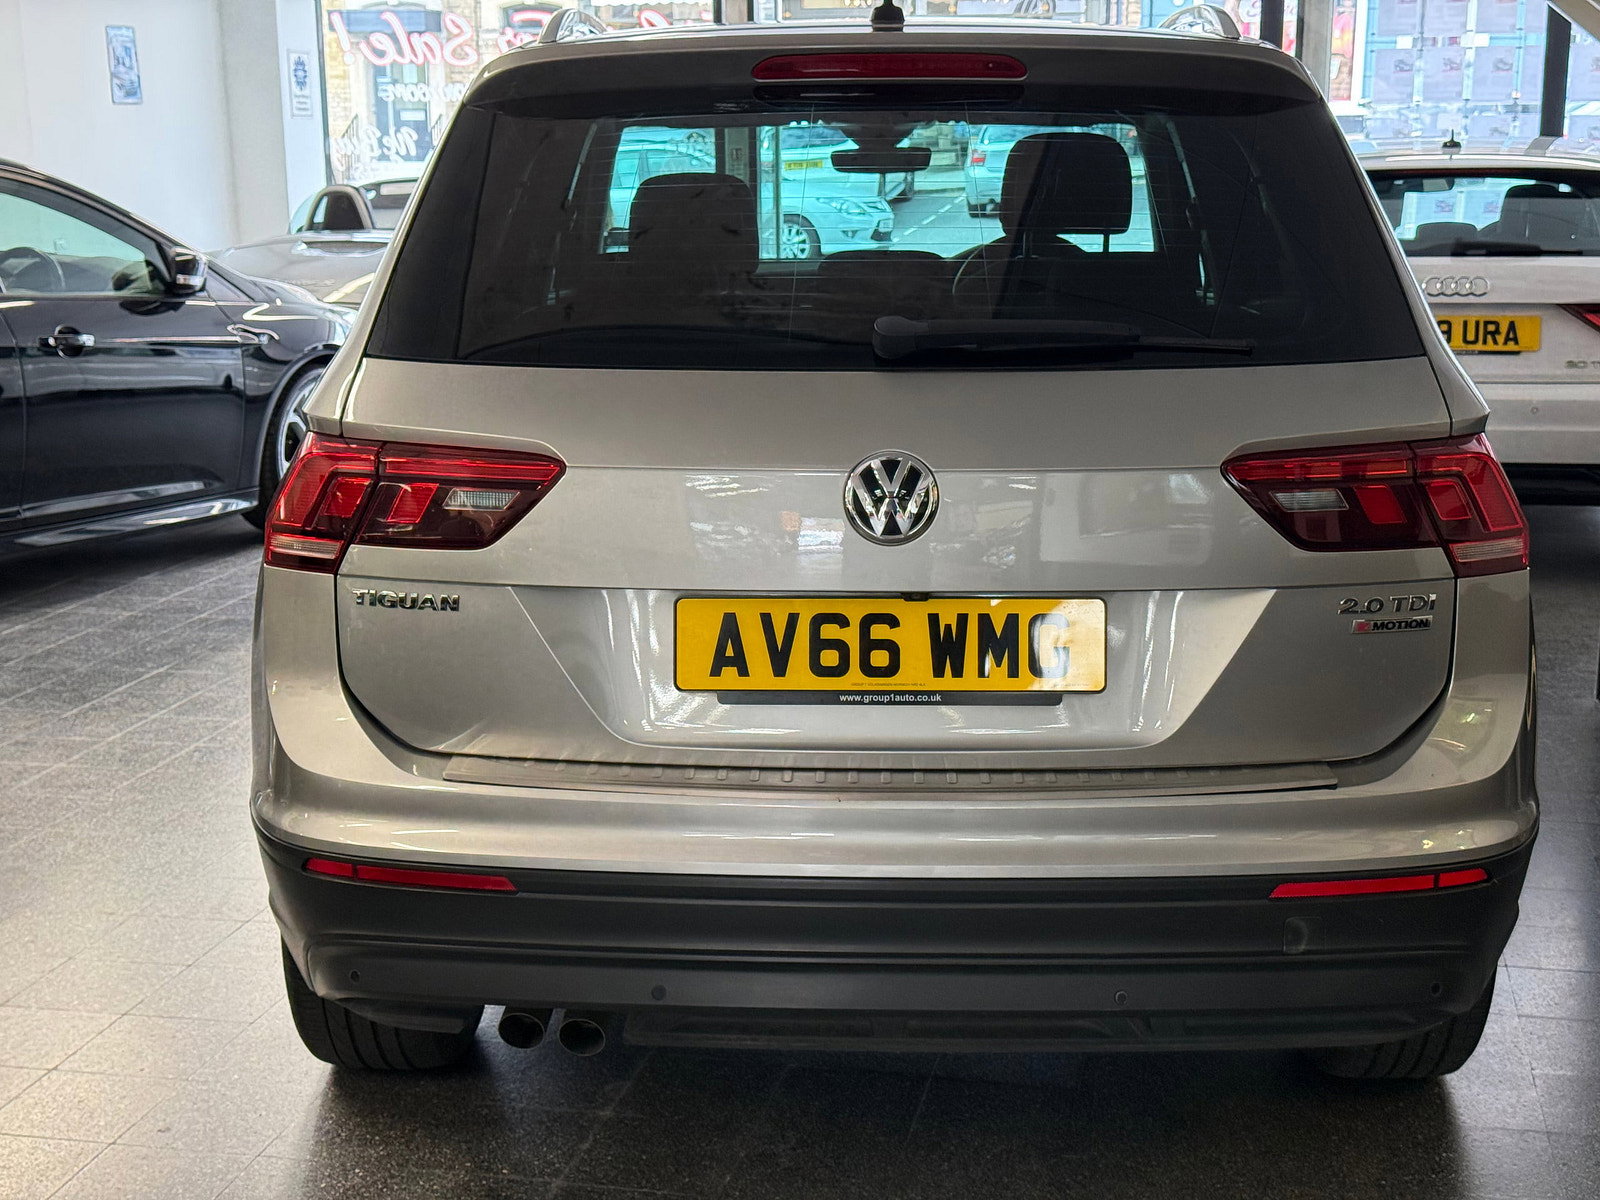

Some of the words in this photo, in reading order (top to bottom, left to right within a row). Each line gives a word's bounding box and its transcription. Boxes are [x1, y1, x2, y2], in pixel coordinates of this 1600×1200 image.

[1462, 320, 1519, 346] URA
[352, 588, 460, 612] TIGUAN
[709, 612, 901, 679] AV66
[927, 613, 1070, 679] WMG
[839, 693, 942, 704] www.group1auto.co.uk
